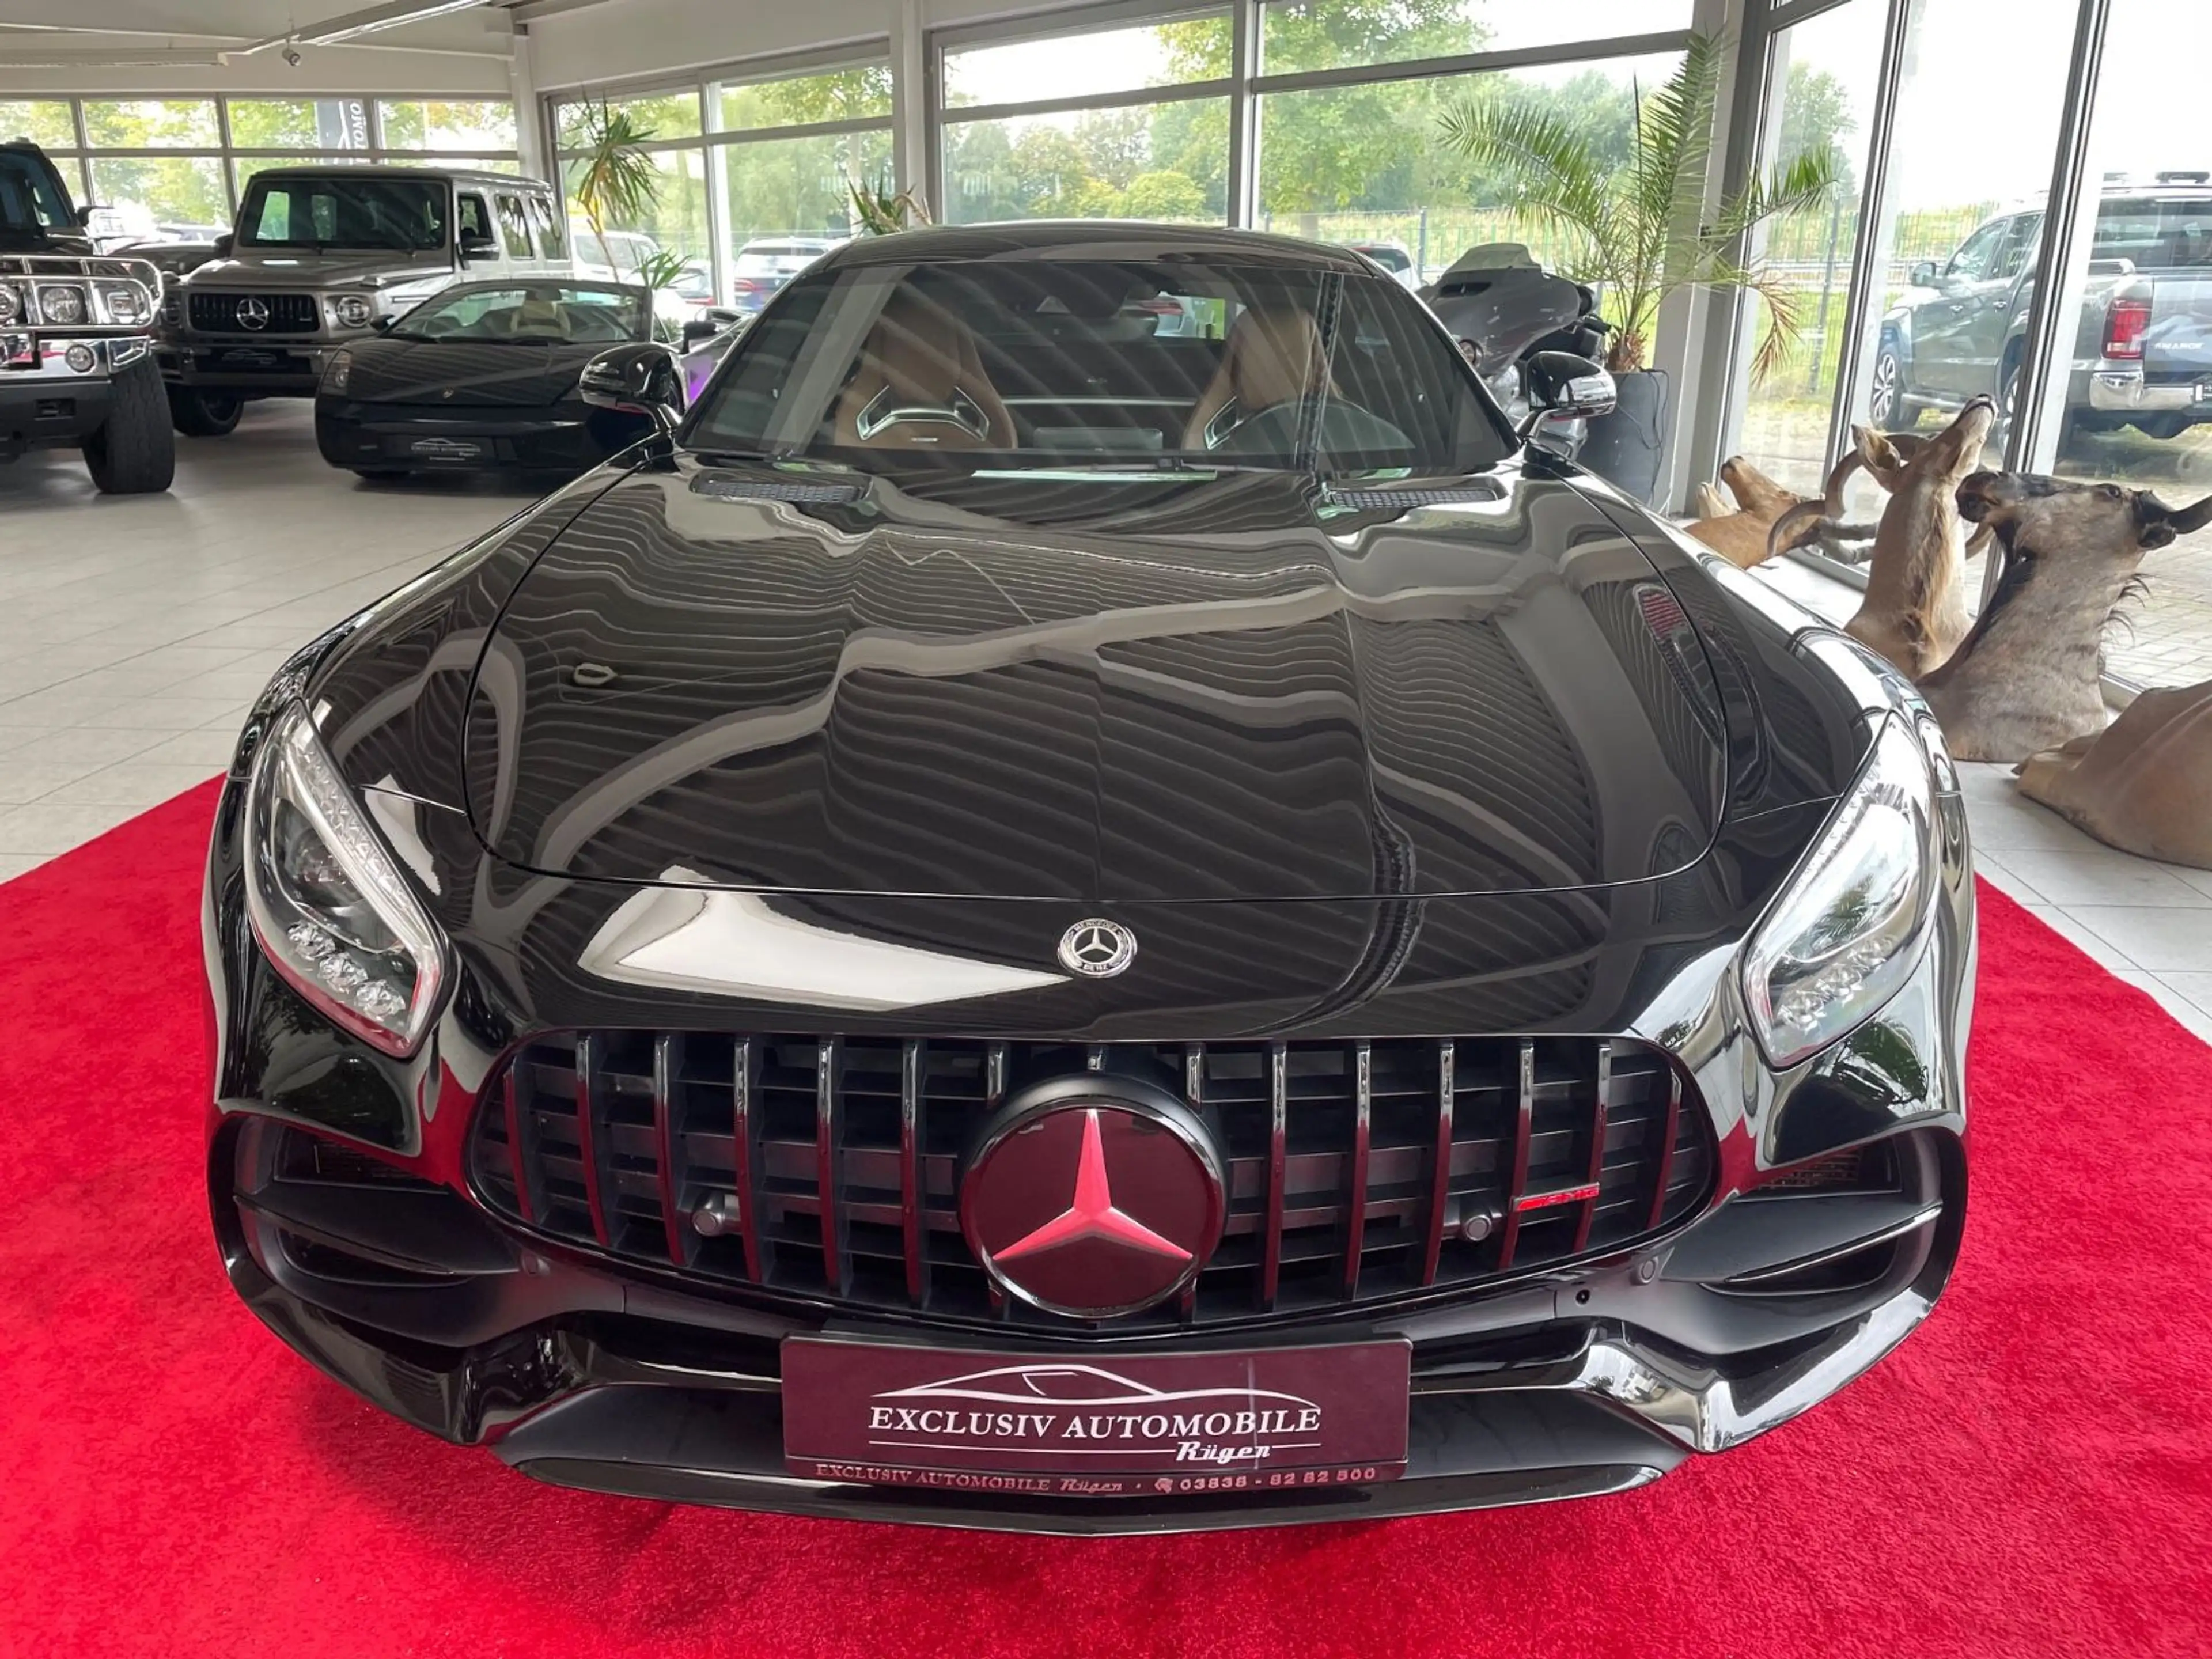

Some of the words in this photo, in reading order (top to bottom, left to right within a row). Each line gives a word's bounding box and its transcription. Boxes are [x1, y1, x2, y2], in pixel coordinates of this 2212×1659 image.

[868, 1406, 1056, 1437] EXCLUSIV
[1062, 1408, 1321, 1438] AUTOMOBILE
[1176, 1441, 1271, 1464] Rügen
[816, 1464, 912, 1482] EXCLUSIV
[916, 1472, 1050, 1490] AUTOMOBILE
[1059, 1478, 1123, 1493] Rügen
[1180, 1476, 1247, 1490] 03838
[1270, 1472, 1295, 1486] 82
[1303, 1470, 1328, 1483] 82
[1336, 1468, 1376, 1482] 500
